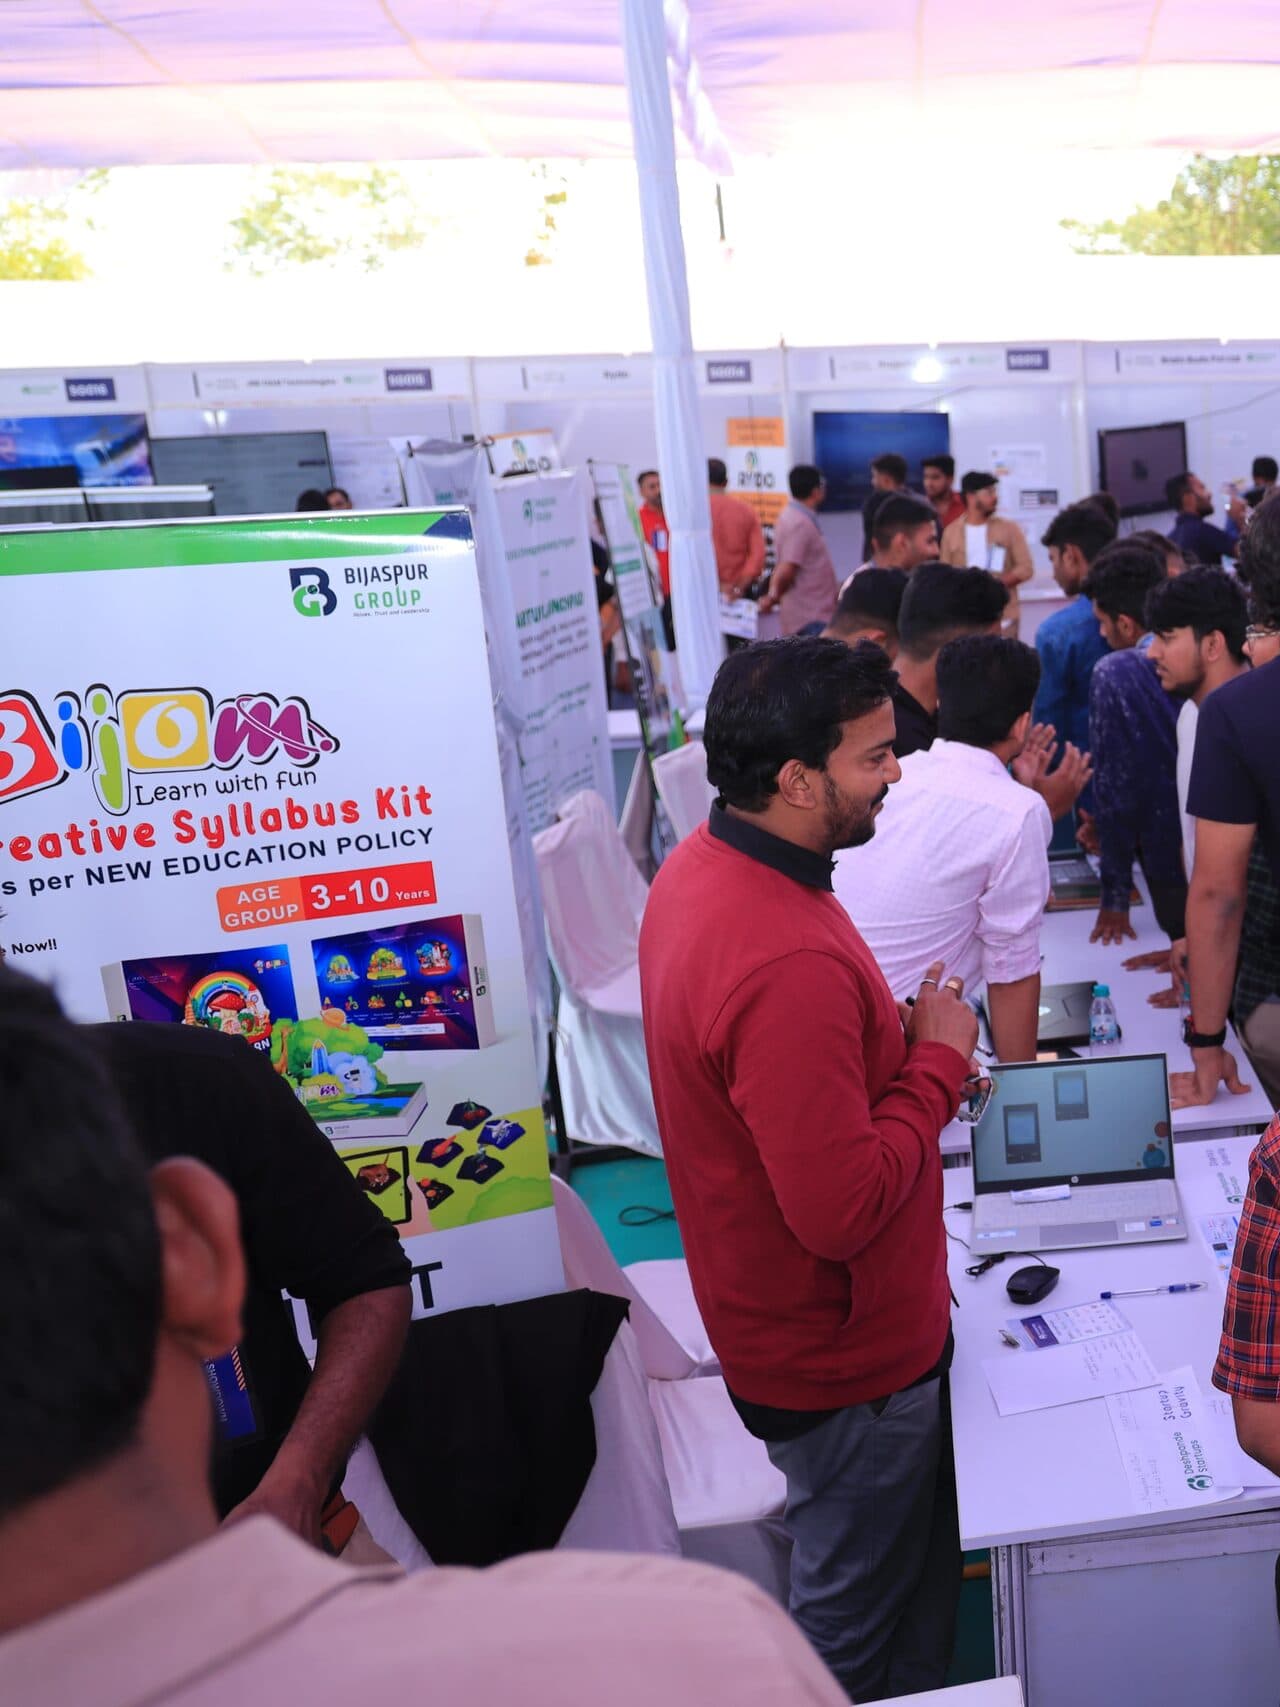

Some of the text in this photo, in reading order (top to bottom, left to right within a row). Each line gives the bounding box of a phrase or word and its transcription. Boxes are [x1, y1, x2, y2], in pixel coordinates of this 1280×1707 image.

[344, 563, 429, 587] BIJASPUR
[353, 586, 422, 609] GROUP
[135, 770, 318, 806] Learn with fun
[0, 785, 433, 862] eative Syllabus Kit
[29, 873, 75, 897] per
[86, 860, 152, 887] NEW
[163, 838, 326, 877] EDUCATION
[337, 826, 433, 855] POLICY
[237, 884, 282, 905] AGE
[309, 876, 431, 910] 3-10 Years
[224, 903, 299, 928] GROUP
[11, 938, 58, 955] Now!!
[1174, 1385, 1192, 1419] Gravity
